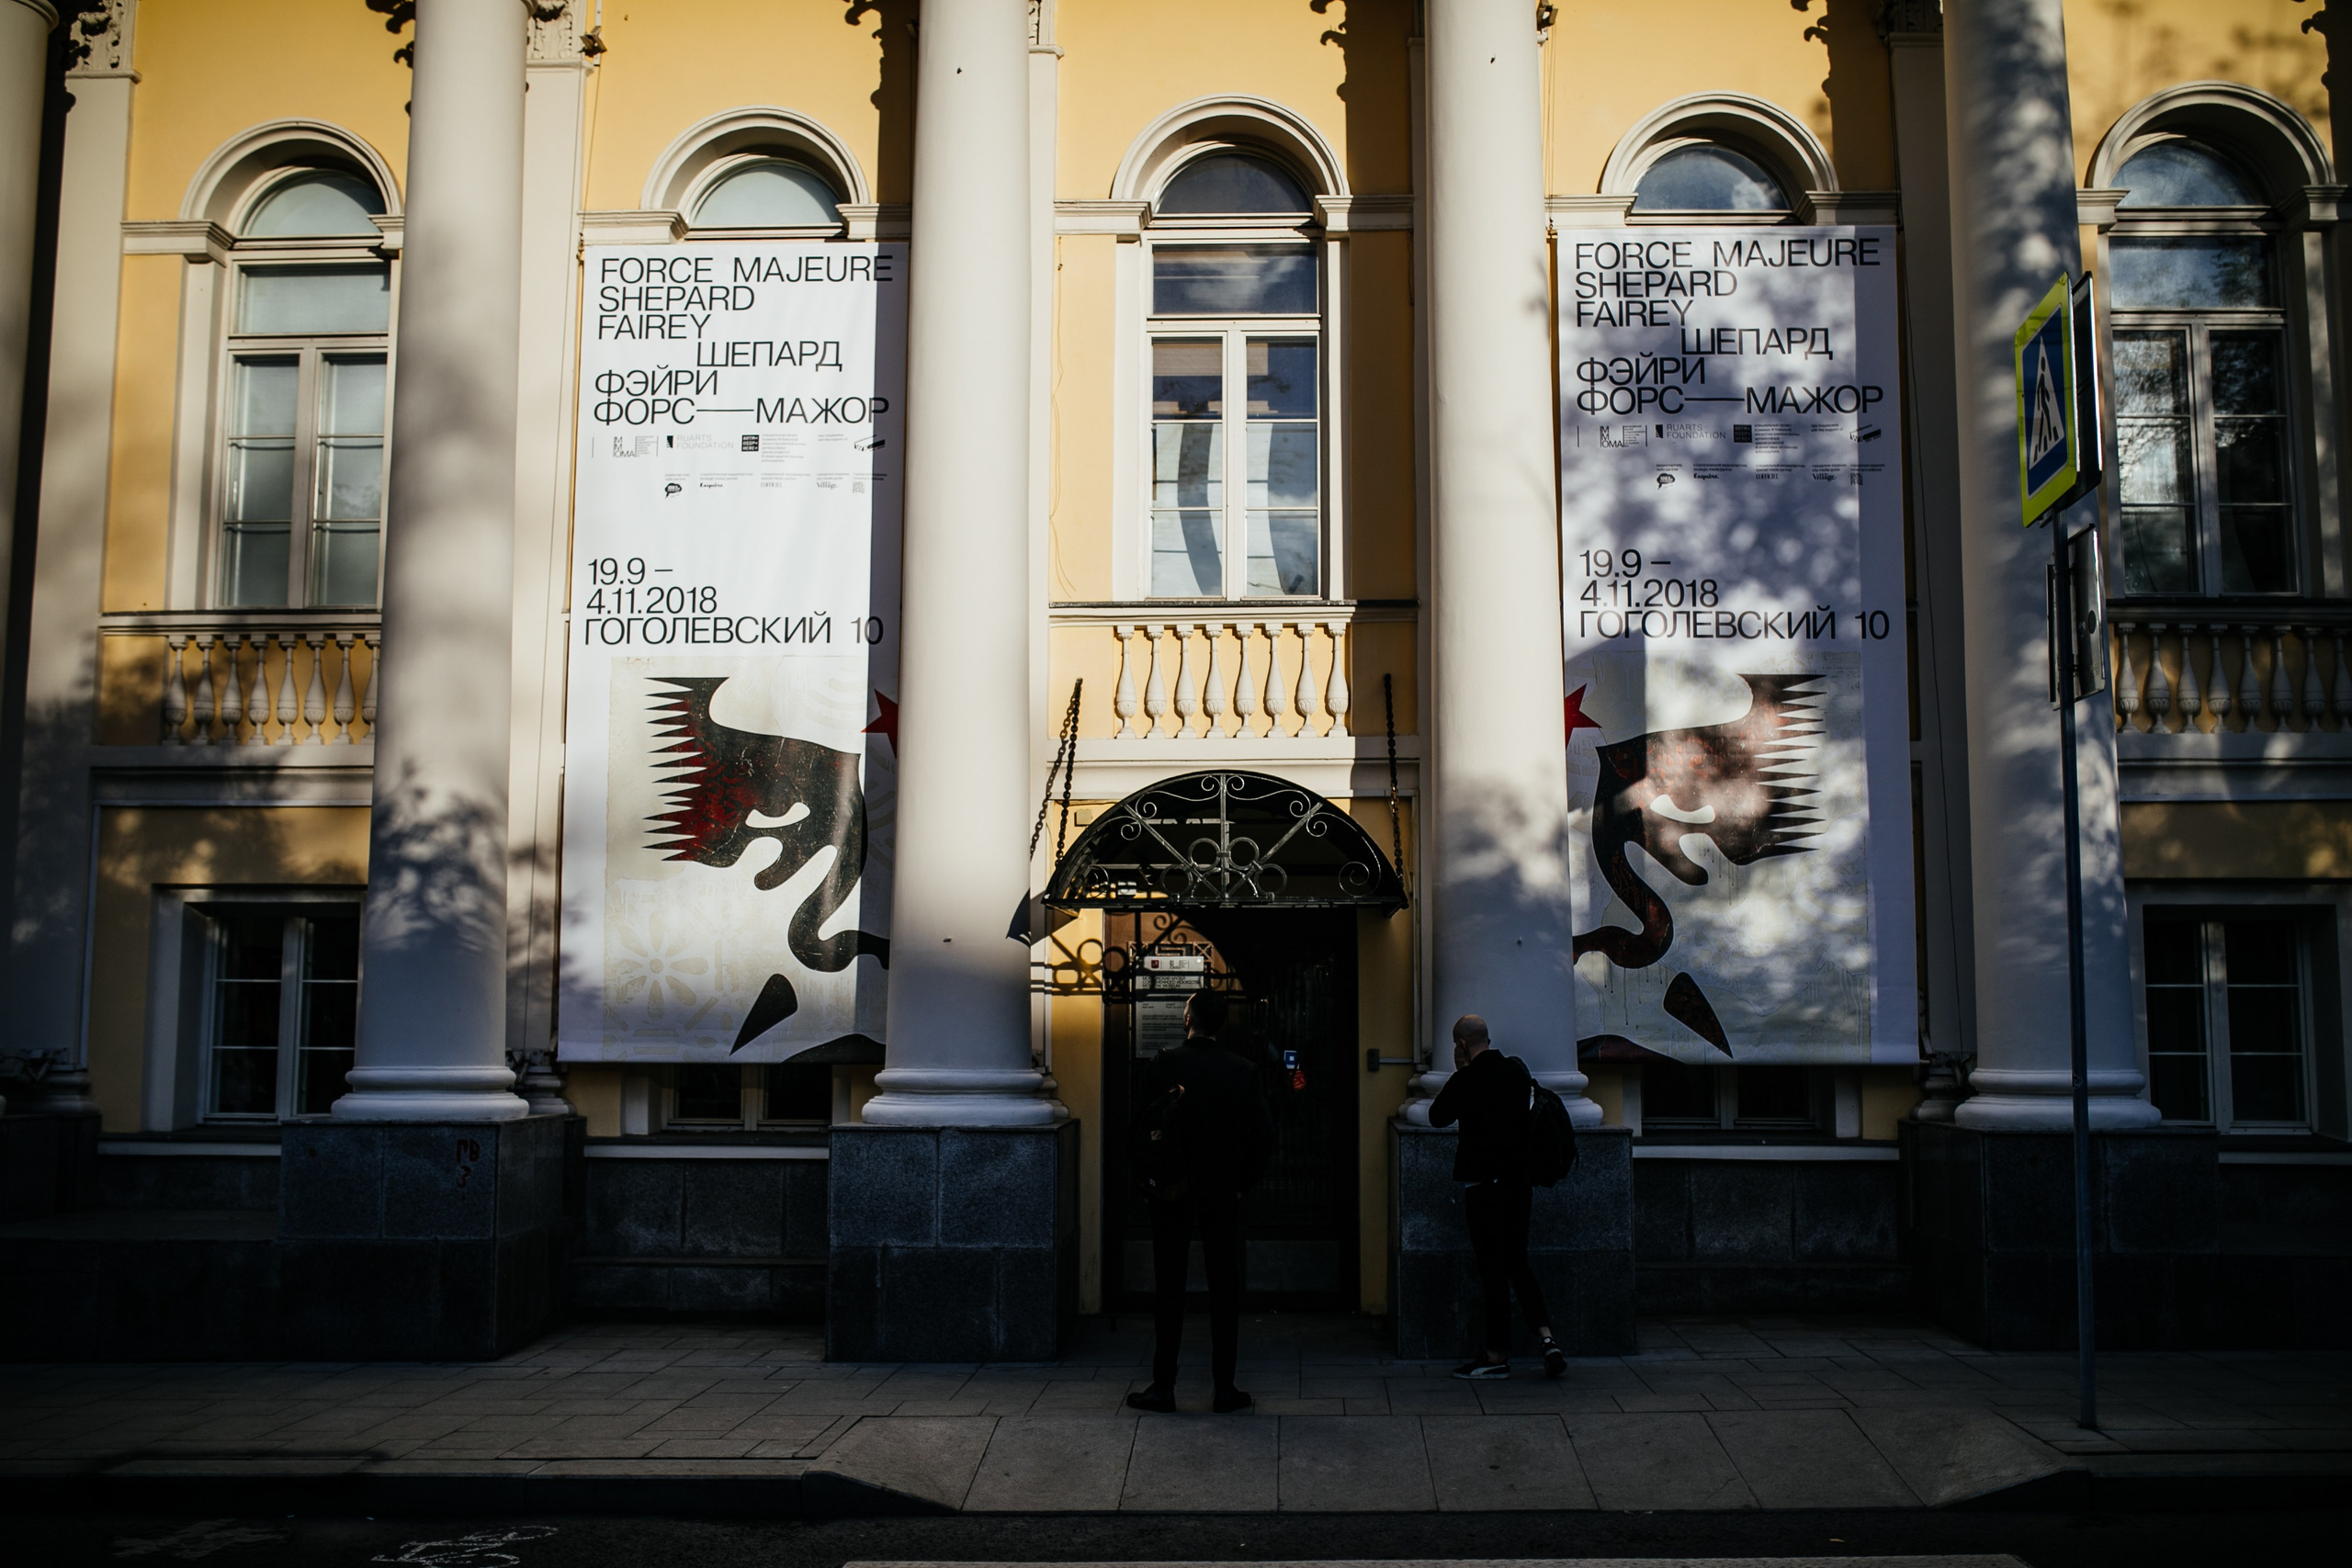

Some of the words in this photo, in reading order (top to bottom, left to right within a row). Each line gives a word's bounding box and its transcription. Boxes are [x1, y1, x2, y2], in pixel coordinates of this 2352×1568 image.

[1575, 241, 1692, 269] FORCE
[1713, 238, 1881, 267] MAJEURE
[601, 258, 713, 284] FORCE
[734, 255, 893, 283] MAJEURE
[599, 286, 755, 312] SHEPARD
[1575, 270, 1737, 299] SHEPARD
[598, 314, 712, 340] FAIREY
[1577, 299, 1693, 328] FAIREY
[696, 341, 842, 372] ШЕПАРД
[1680, 327, 1833, 360] ШЕПАРД
[594, 365, 718, 398] ФЭЙРИ
[1576, 352, 1705, 386] ФЭЙРИ
[676, 434, 712, 443] RUARTS
[1667, 423, 1702, 432] RUARTS
[588, 558, 646, 585] 19.9
[1579, 549, 1642, 578] 19.9
[586, 586, 718, 614] 4.11.2018
[1580, 579, 1719, 607] 4.11.2018
[585, 611, 831, 646] ГОГОЛЕВСКИЙ
[850, 615, 884, 646] 10
[1579, 604, 1836, 640] ГОГОЛЕВСКИЙ
[1854, 610, 1890, 640] 10
